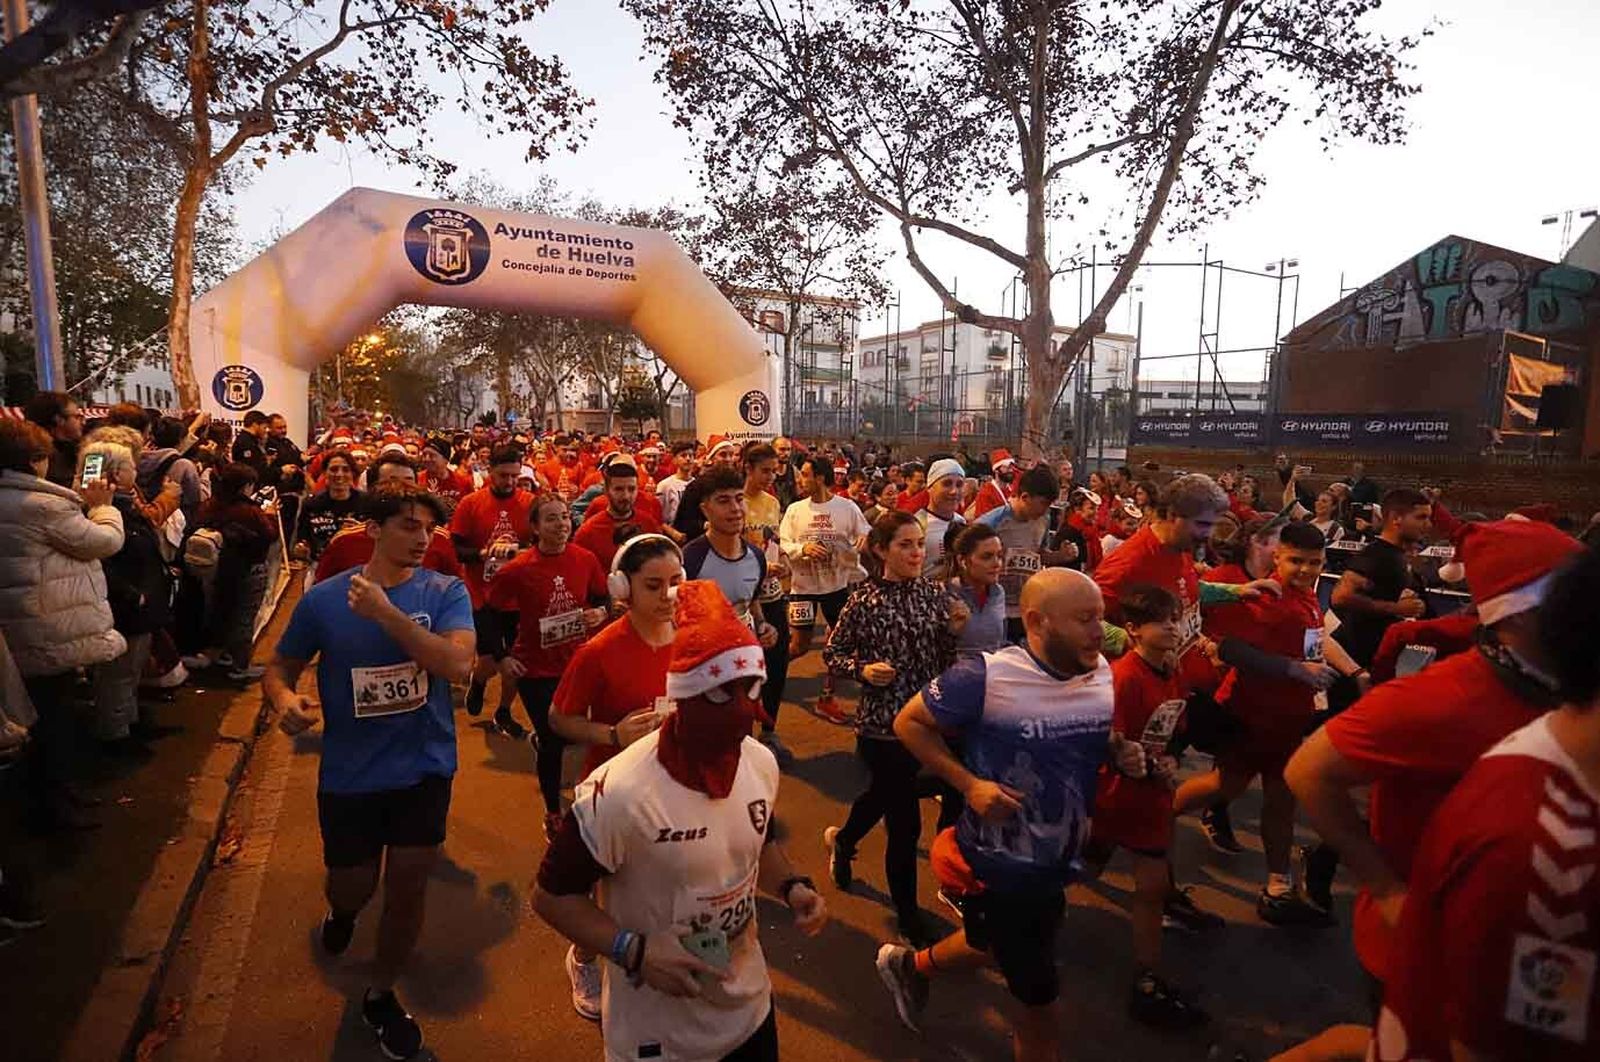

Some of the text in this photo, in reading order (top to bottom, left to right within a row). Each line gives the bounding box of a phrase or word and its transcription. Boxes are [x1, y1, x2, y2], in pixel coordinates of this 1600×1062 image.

[494, 222, 634, 251] Ayuntamiento
[537, 243, 635, 268] de Huelva
[569, 265, 583, 277] de
[586, 266, 637, 282] Deportes
[1154, 422, 1191, 430] HYUNDAI
[1217, 422, 1258, 430] HYUNDAI
[1301, 421, 1350, 431] HYUNDAI
[1389, 421, 1449, 431] HYUNDAI
[795, 608, 811, 619] 561
[383, 678, 419, 699] 361
[1021, 718, 1044, 739] 31
[655, 827, 707, 843] Zeus
